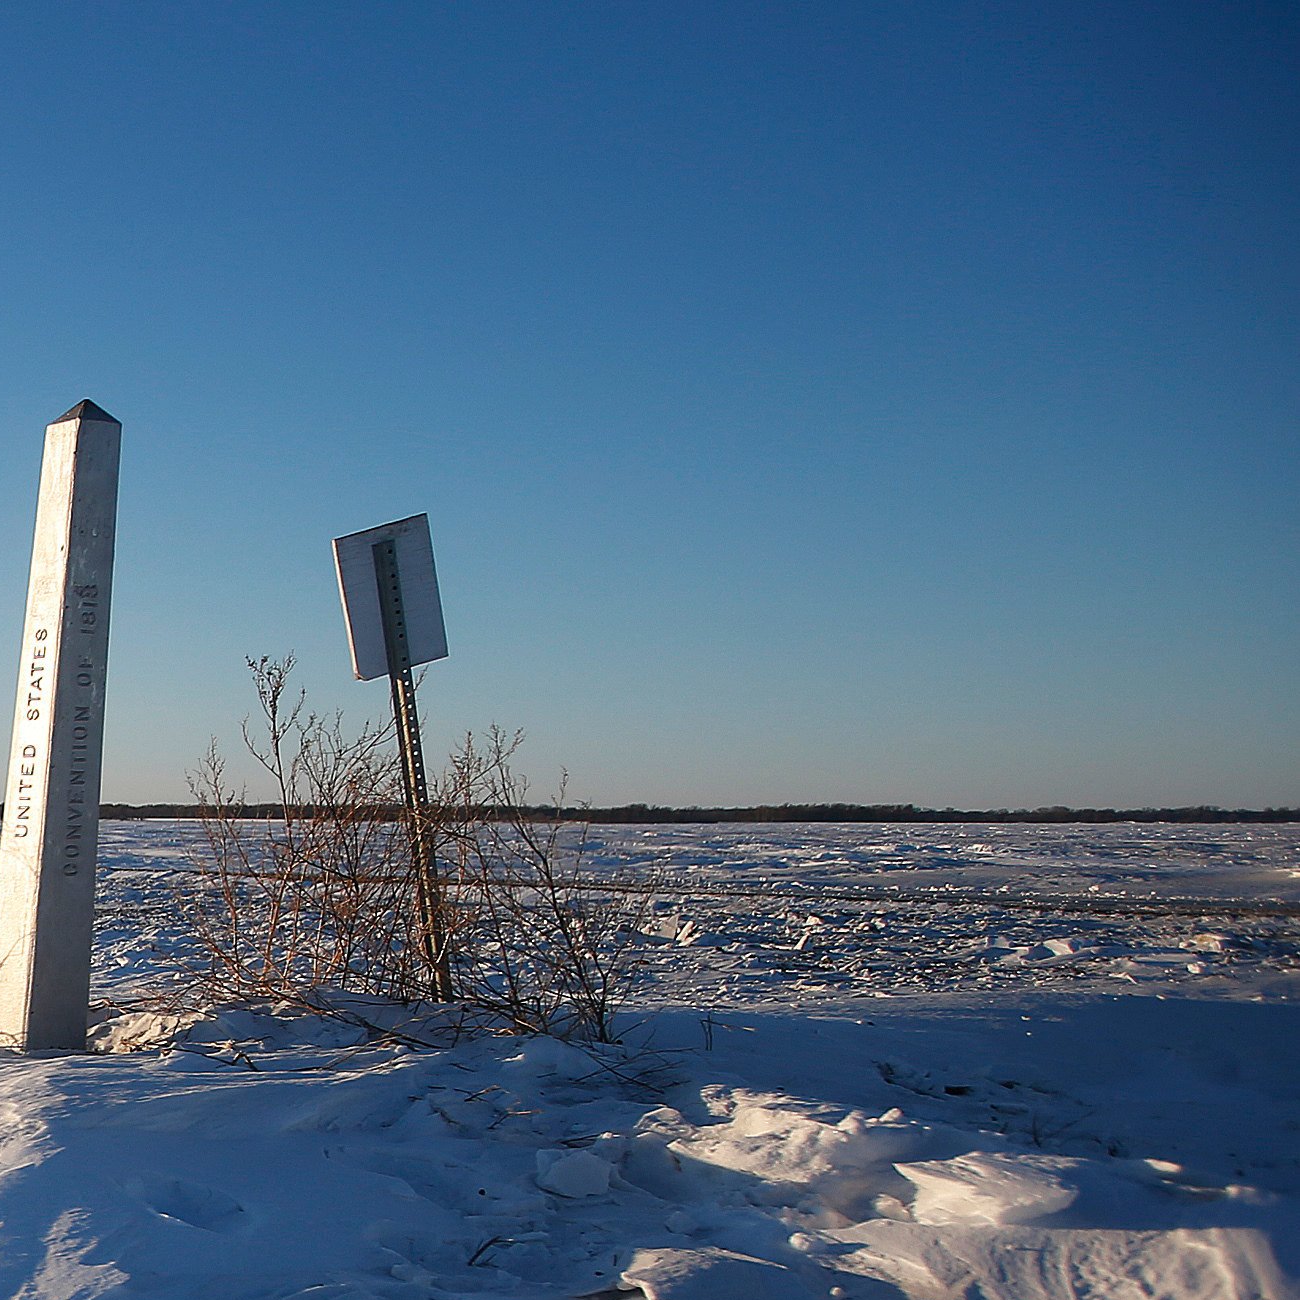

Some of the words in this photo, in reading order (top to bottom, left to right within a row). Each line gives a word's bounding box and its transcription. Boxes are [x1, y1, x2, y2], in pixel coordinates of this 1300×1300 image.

[14, 744, 36, 838] UNITED
[26, 627, 48, 721] STATES
[75, 655, 94, 688] OF
[62, 705, 91, 877] CONVENTION
